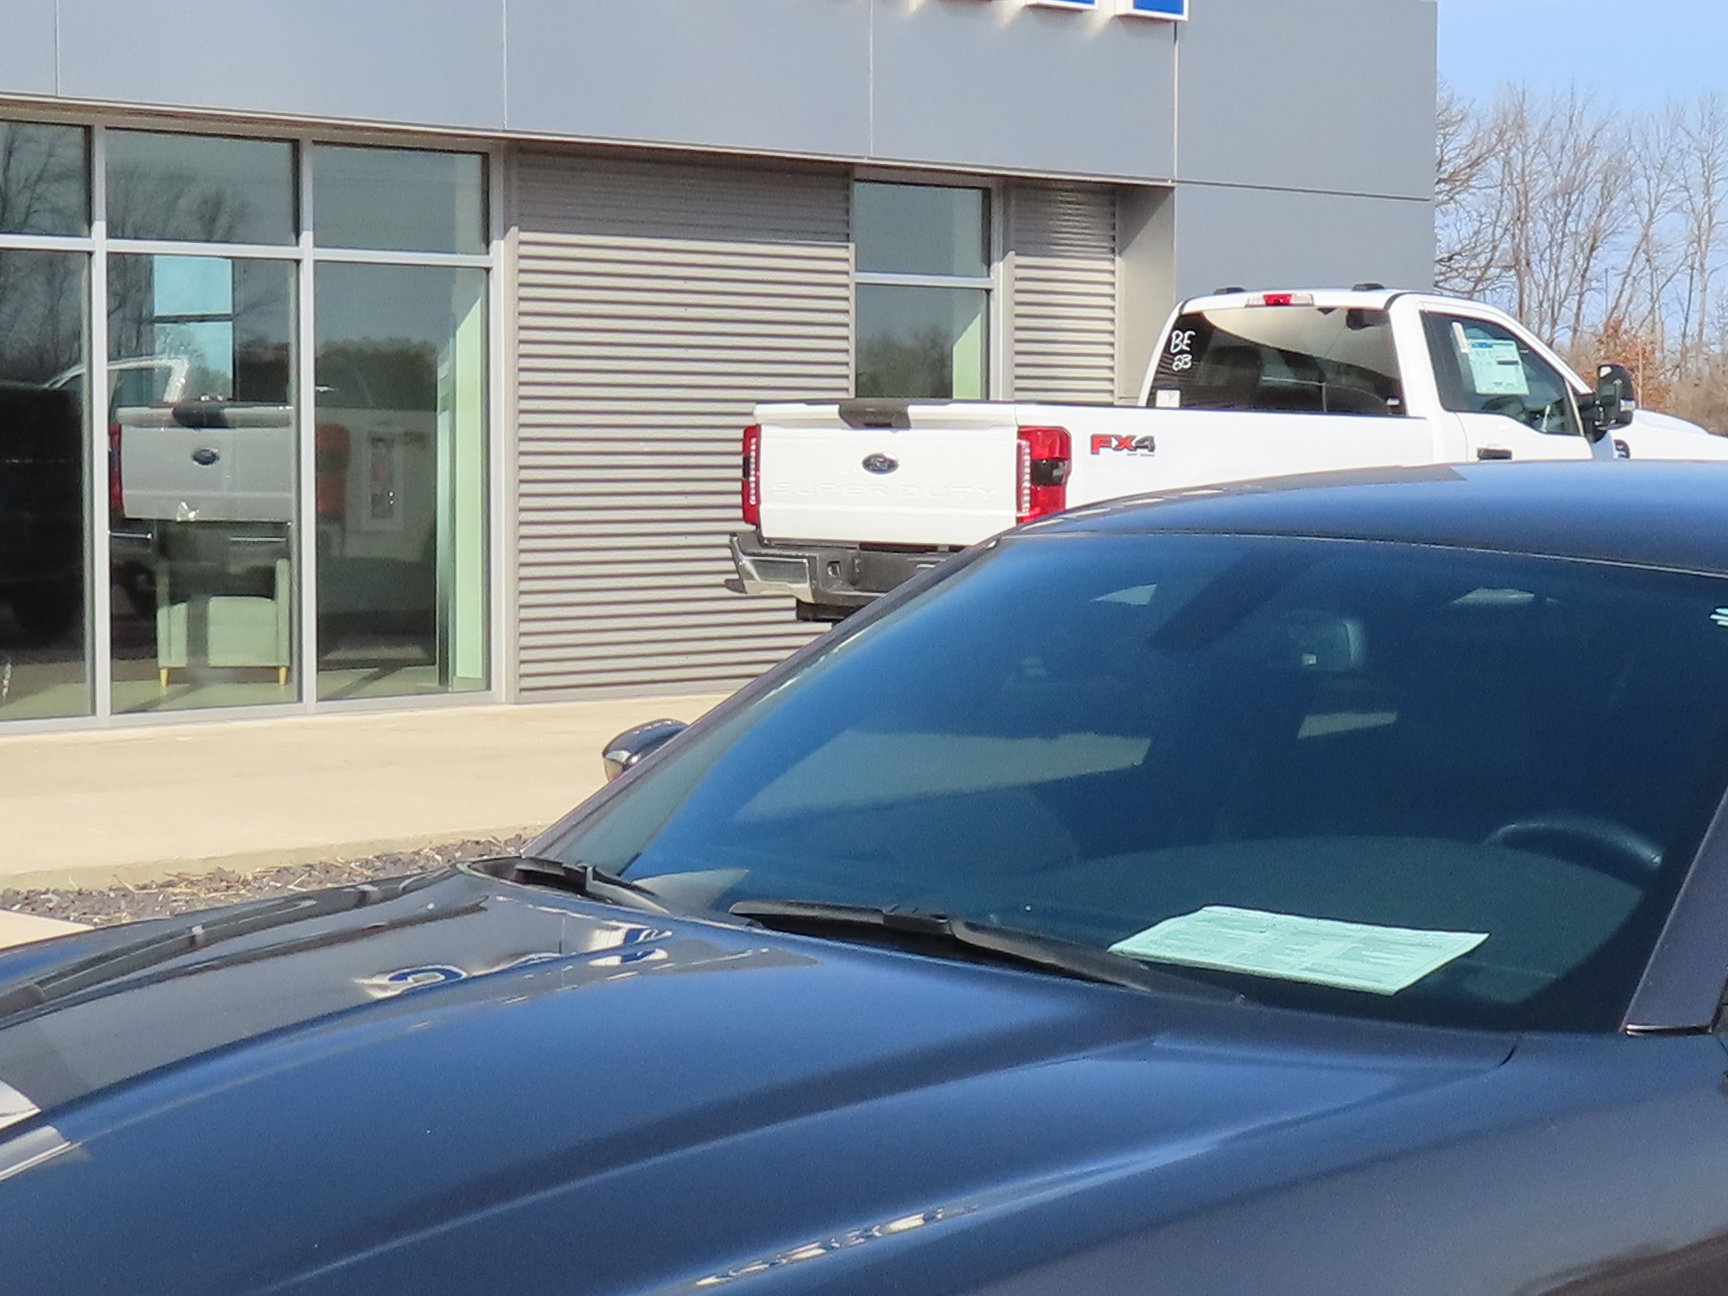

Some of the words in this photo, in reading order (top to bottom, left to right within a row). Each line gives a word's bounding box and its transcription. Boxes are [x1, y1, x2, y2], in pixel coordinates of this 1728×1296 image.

[1170, 330, 1196, 353] BE
[1090, 434, 1156, 455] FX4
[771, 481, 889, 497] SUPER
[898, 483, 1000, 501] DUTY
